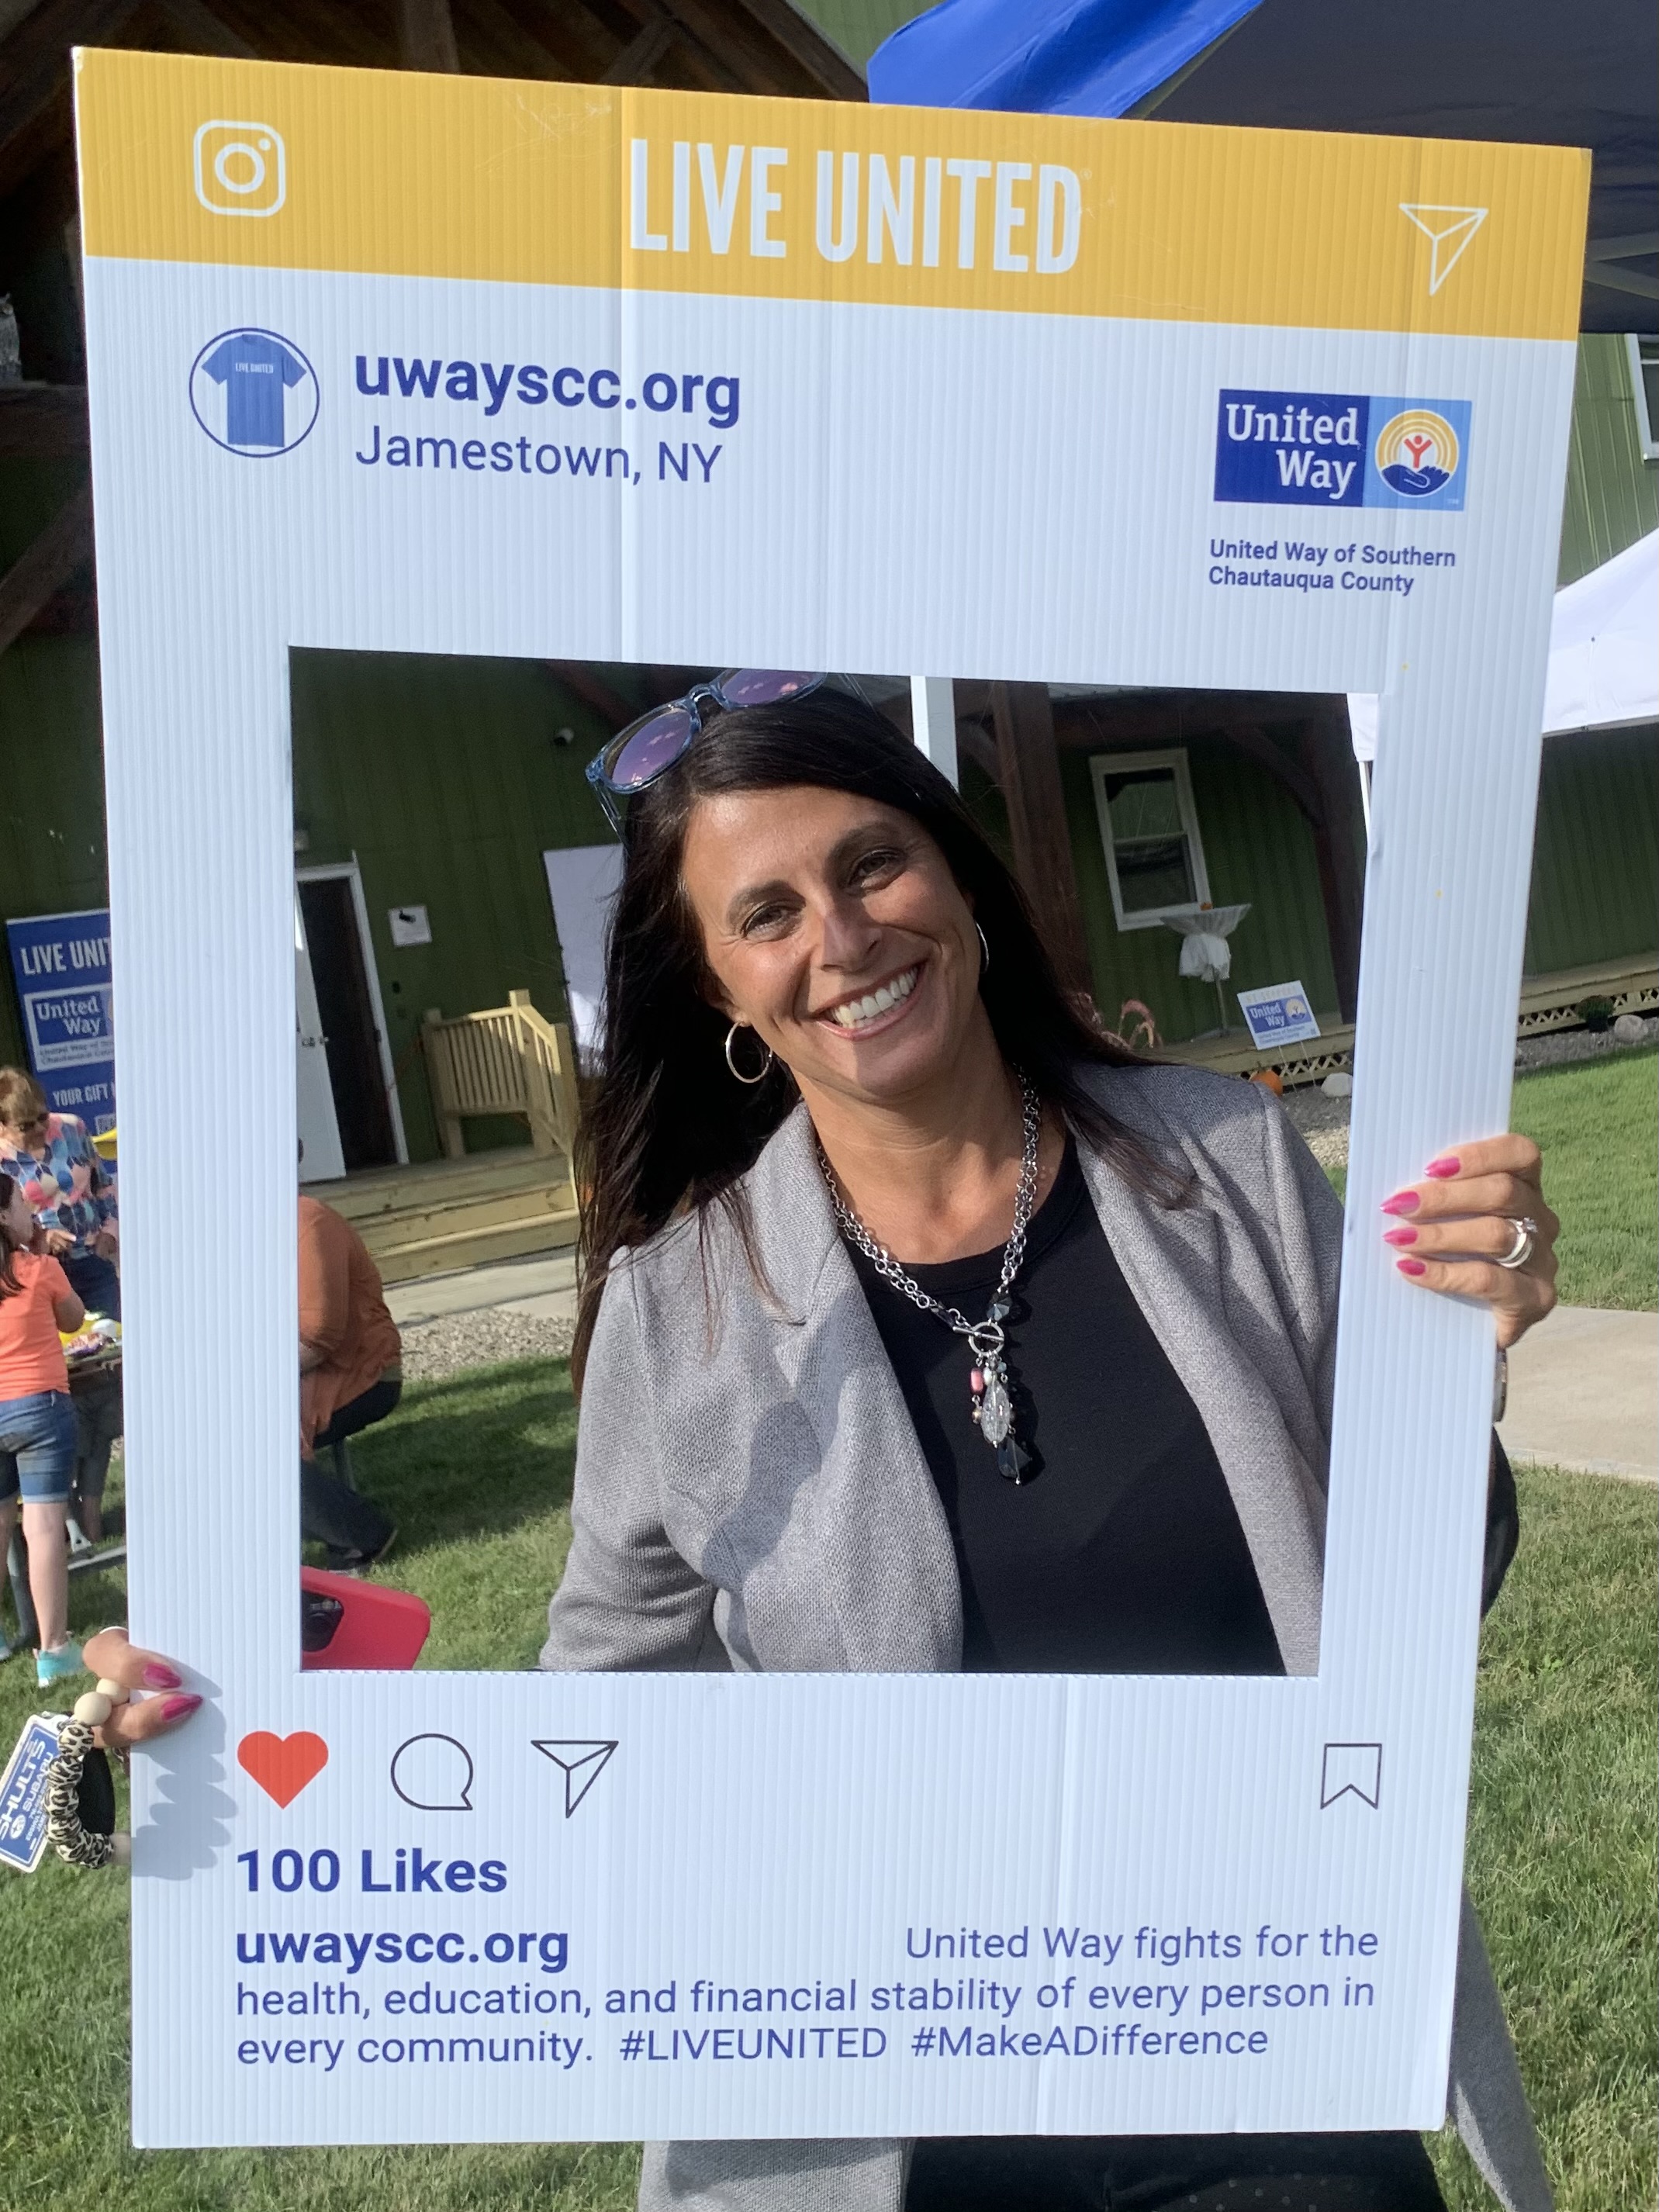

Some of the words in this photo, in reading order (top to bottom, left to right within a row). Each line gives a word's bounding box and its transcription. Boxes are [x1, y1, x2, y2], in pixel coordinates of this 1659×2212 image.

[631, 139, 787, 257] LIVE
[816, 150, 1082, 274] UNITED
[356, 355, 739, 430] uwayscc.org
[1225, 404, 1359, 445] United
[356, 426, 641, 486] Jamestown,
[658, 441, 723, 482] NY
[1277, 449, 1357, 499] Way
[1210, 539, 1278, 560] United
[1284, 542, 1328, 565] Way
[1333, 544, 1357, 563] of
[1360, 544, 1457, 567] Southern
[1208, 566, 1334, 593] Chautauqua
[1340, 572, 1415, 596] County
[20, 942, 67, 976] LIVE
[36, 996, 100, 1021] United
[64, 1017, 101, 1037] Way
[1249, 1002, 1282, 1018] United
[1265, 1014, 1285, 1027] Way
[53, 1087, 83, 1107] YOUR
[84, 1083, 109, 1102] GIFT
[237, 1849, 340, 1892] 100
[361, 1848, 507, 1892] Likes
[237, 1932, 569, 1975] uwayscc.org
[907, 1926, 1028, 1958] United
[1043, 1927, 1124, 1965] Way
[1134, 1926, 1243, 1966] fights
[1256, 1925, 1309, 1957] for
[1319, 1925, 1378, 1956] the
[237, 1982, 370, 2019] health,
[384, 1982, 592, 2018] education,
[605, 1981, 676, 2013] and
[690, 1979, 856, 2013] financial
[870, 1978, 1021, 2017] stability
[1036, 1976, 1077, 2008] of
[1088, 1984, 1190, 2016] every
[1201, 1981, 1329, 2015] person
[1343, 1977, 1374, 2006] in
[237, 2038, 344, 2072] every
[358, 2031, 593, 2069] community.
[619, 2028, 887, 2061] #LIVEUNITED
[911, 2024, 1269, 2057] #MakeADifference
